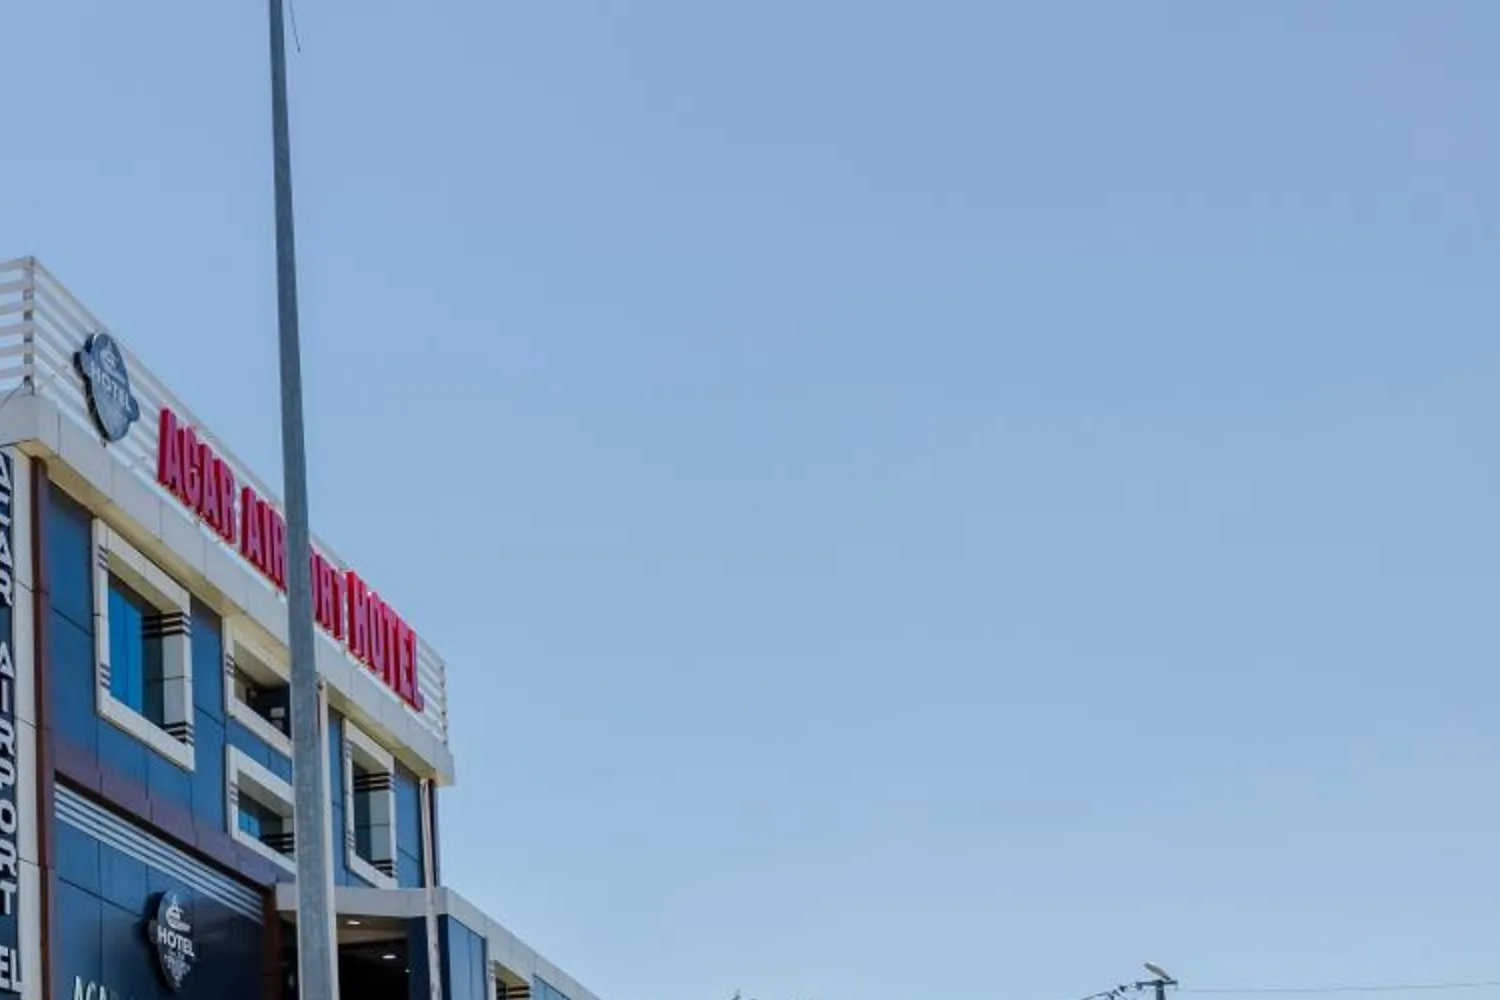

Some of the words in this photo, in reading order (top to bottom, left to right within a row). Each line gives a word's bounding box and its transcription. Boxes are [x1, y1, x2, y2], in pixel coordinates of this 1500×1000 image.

[157, 408, 237, 545] ACAR
[241, 486, 346, 641] AIRRT
[347, 569, 425, 712] HOTEL
[157, 925, 195, 957] HOTEL
